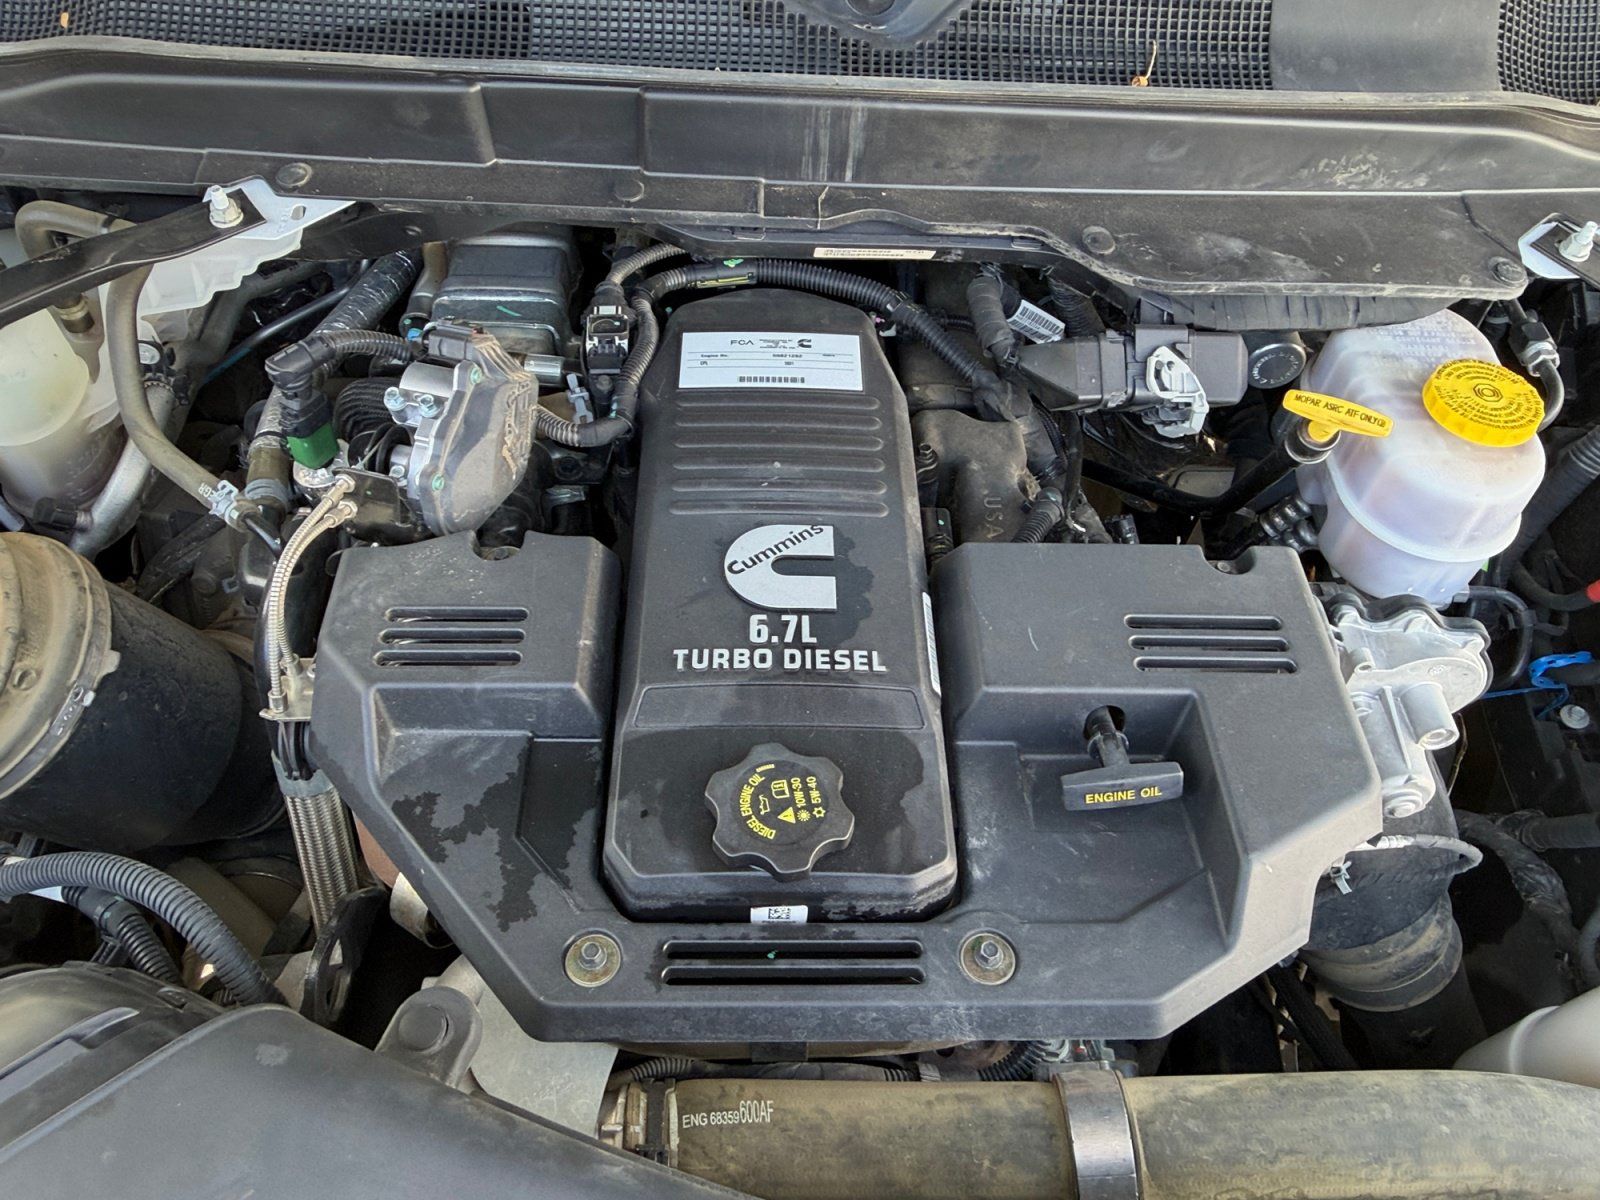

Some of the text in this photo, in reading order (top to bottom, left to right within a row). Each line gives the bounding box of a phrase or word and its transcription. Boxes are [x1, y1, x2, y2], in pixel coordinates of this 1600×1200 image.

[1294, 393, 1321, 407] MOPAR
[1345, 407, 1361, 418] ATF
[1360, 412, 1378, 425] ONLY
[727, 524, 824, 575] Cummins
[750, 614, 817, 644] 6.7L
[673, 648, 887, 673] TURBO DIESEL
[790, 777, 807, 808] 10W-30
[806, 776, 822, 804] 5W-40
[1085, 786, 1163, 804] ENGINE OIL
[739, 773, 776, 840] DIESEL ENGINE OIL
[682, 1112, 708, 1129] ENG
